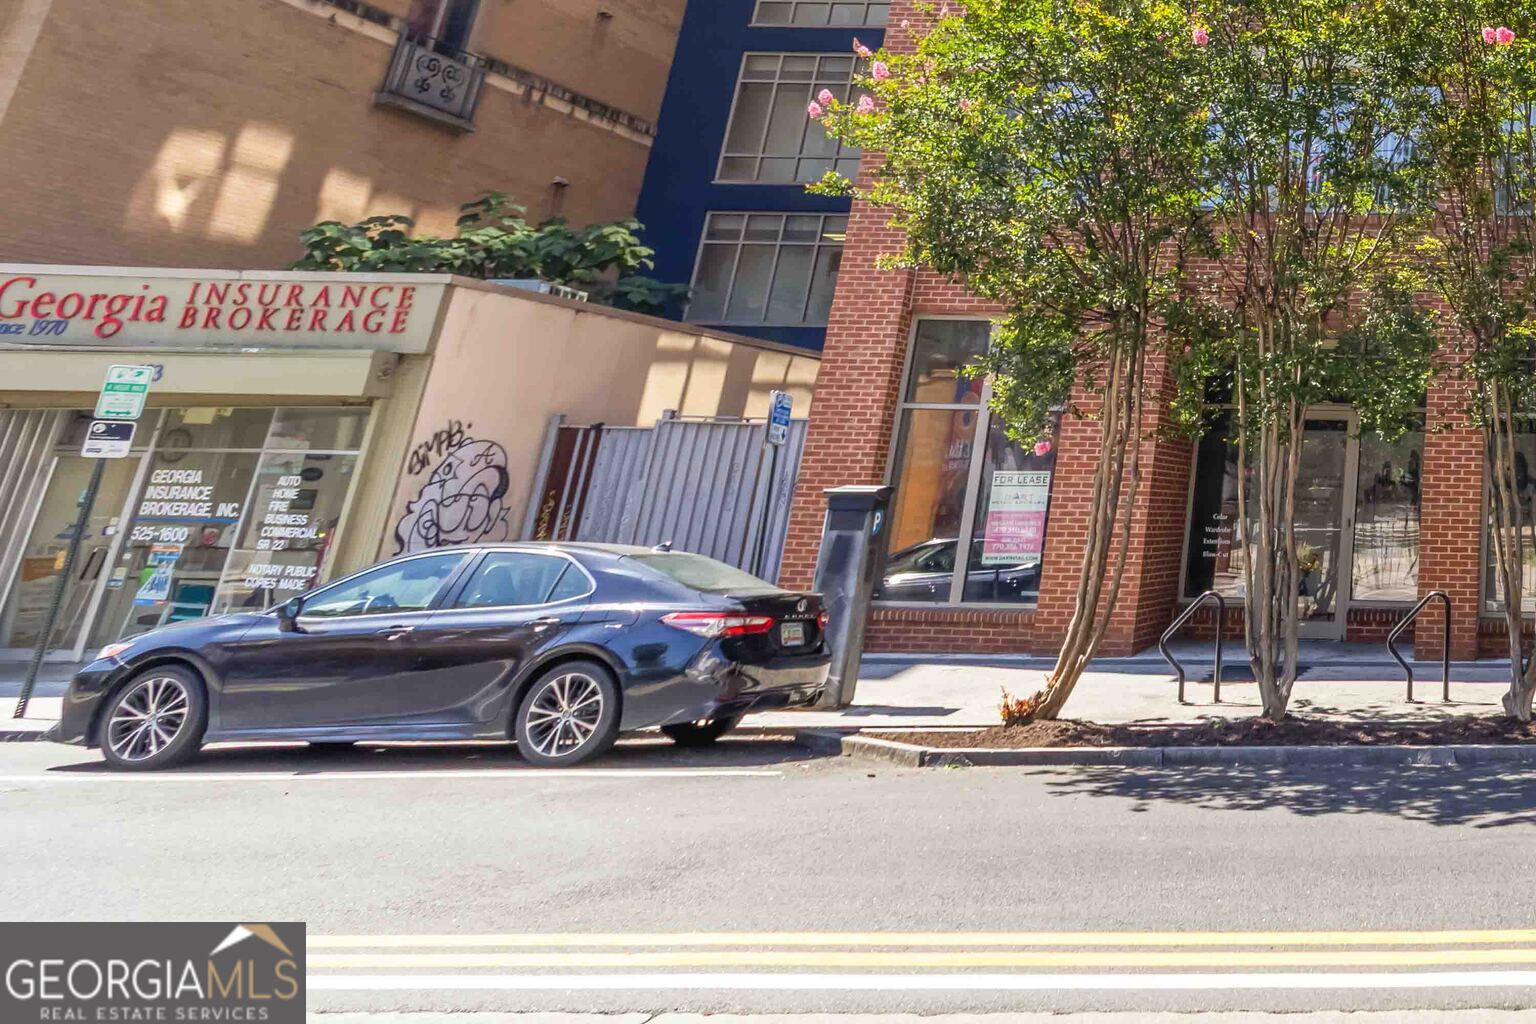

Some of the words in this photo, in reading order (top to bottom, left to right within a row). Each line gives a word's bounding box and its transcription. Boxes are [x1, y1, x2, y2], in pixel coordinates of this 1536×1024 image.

[186, 282, 416, 310] INSURANCE
[0, 277, 167, 338] Georgia
[178, 307, 409, 334] BROKERAGE
[27, 319, 70, 336] 1970
[151, 470, 203, 484] GEORGIA
[277, 476, 301, 486] AUTO
[994, 476, 1013, 484] FOR
[1017, 476, 1048, 484] LEASE
[144, 486, 213, 500] INSURANCE
[272, 488, 299, 499] HOME
[140, 501, 213, 518] BROKERAGE,
[216, 503, 239, 517] INC.
[268, 501, 289, 511] FIRE
[264, 515, 309, 525] BUSINESS
[873, 512, 881, 531] P
[131, 526, 188, 542] 525-1600
[261, 527, 318, 539] COMMERCIAL
[272, 539, 284, 550] 22
[248, 564, 282, 576] NOTARY
[285, 566, 317, 577] PUBLIC
[244, 577, 277, 588] COPIES
[278, 579, 306, 590] MADE
